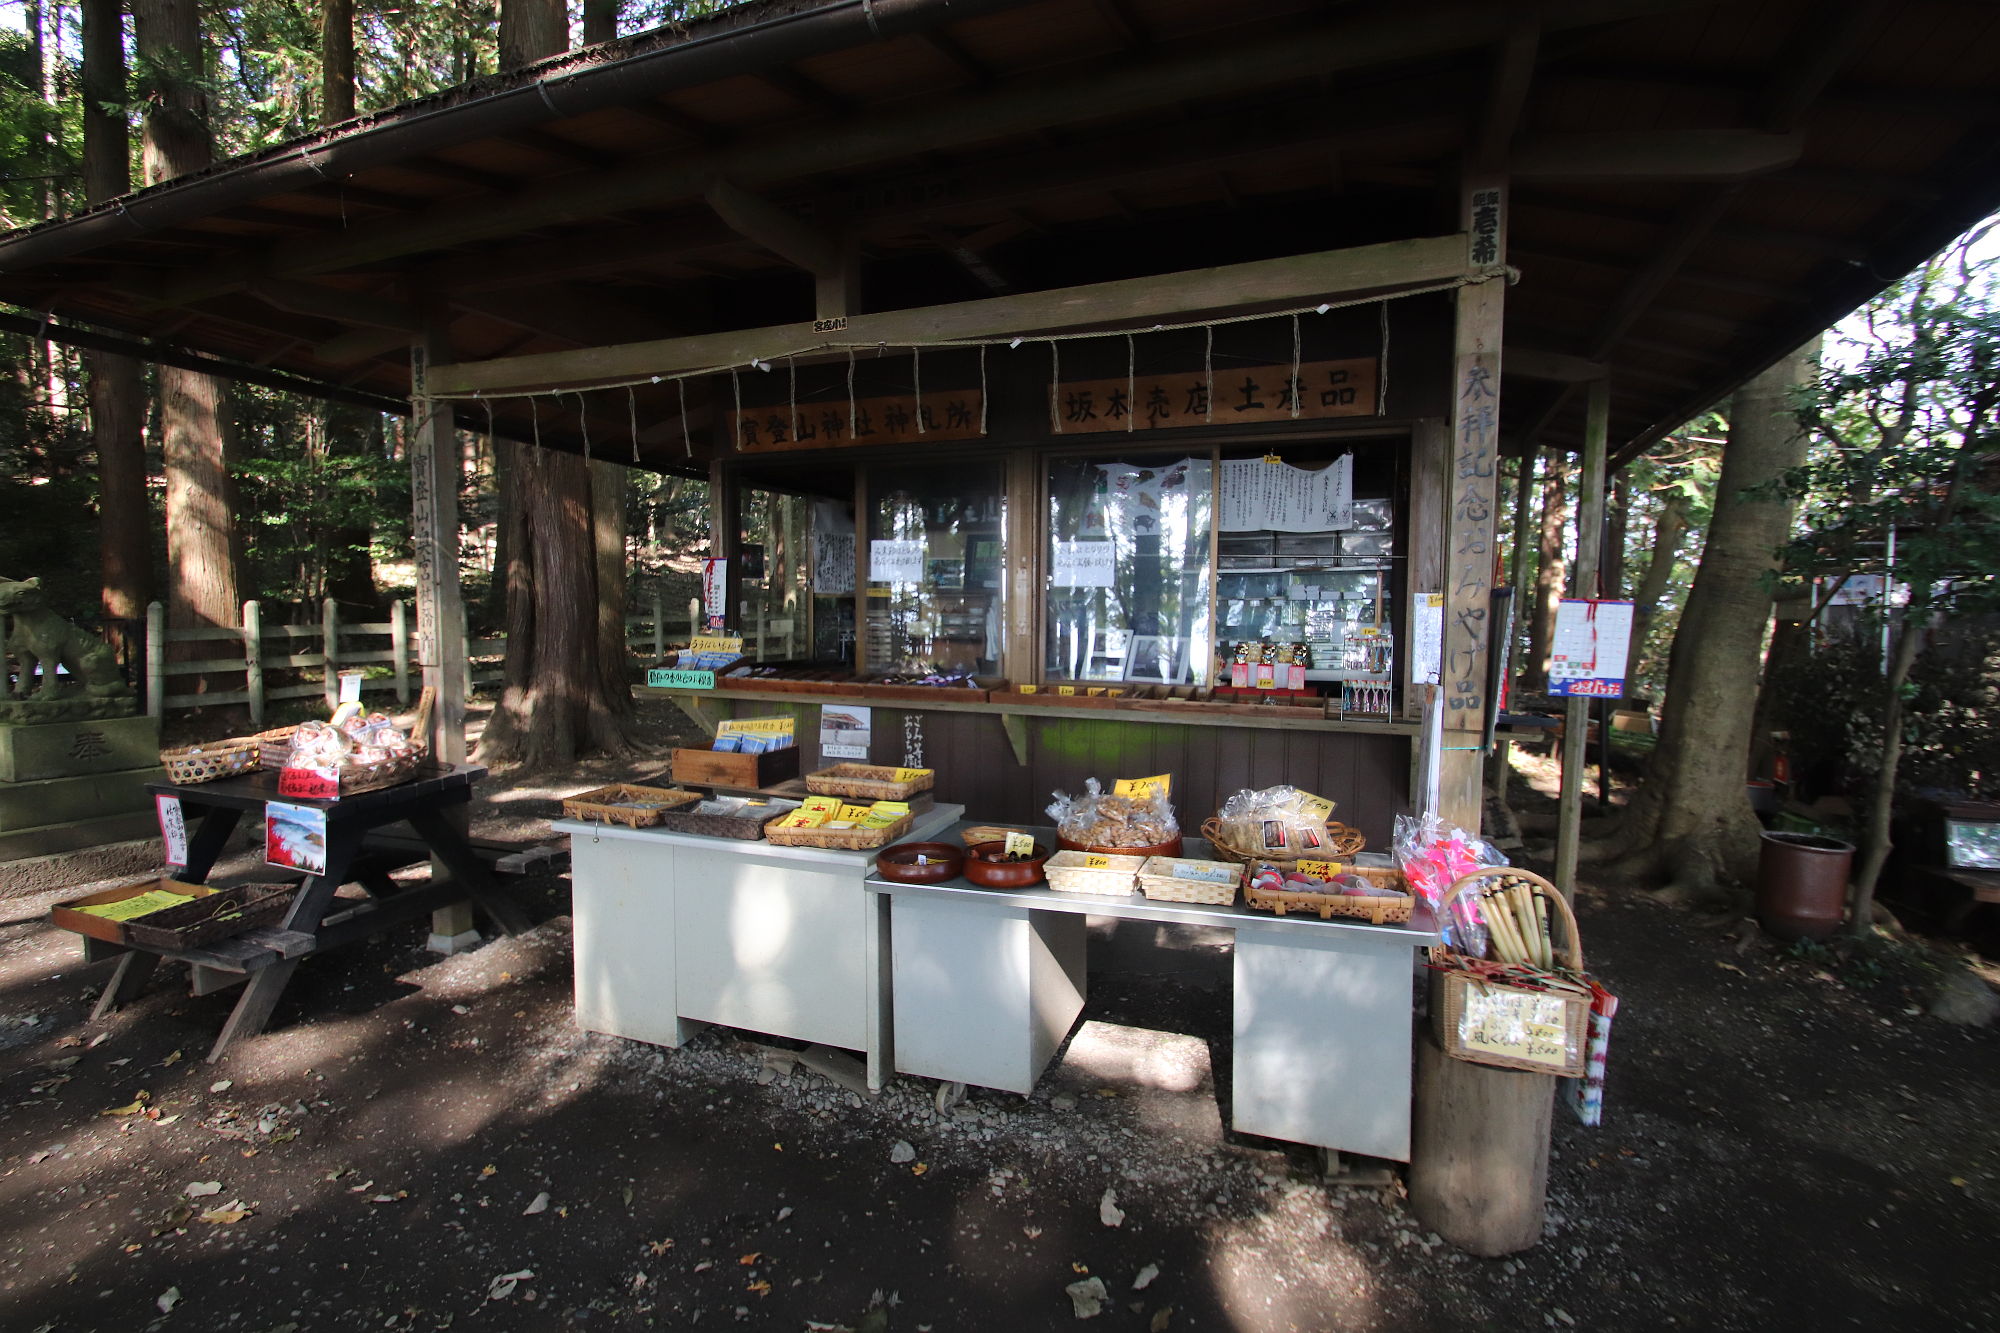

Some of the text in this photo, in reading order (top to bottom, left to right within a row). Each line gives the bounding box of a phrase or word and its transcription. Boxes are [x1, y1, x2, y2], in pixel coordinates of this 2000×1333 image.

[1065, 369, 1358, 423] 坂本売店土産品
[67, 731, 113, 762] 奉
